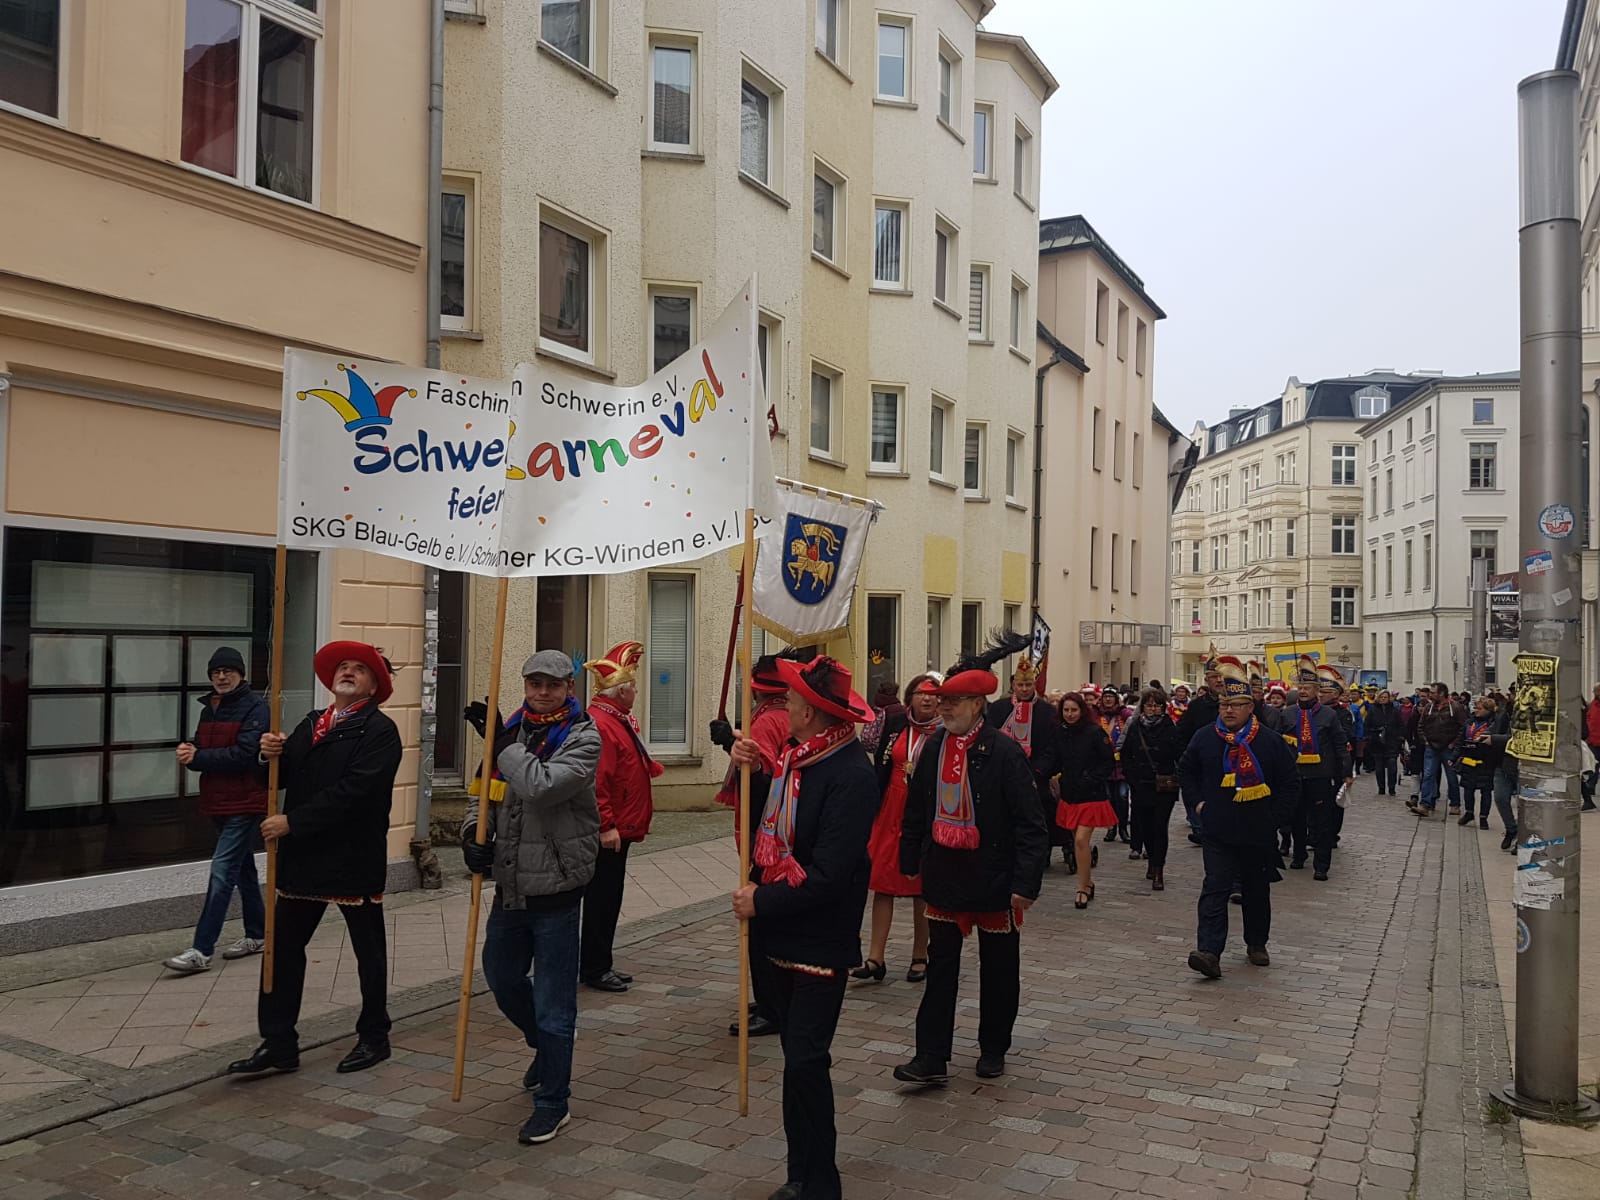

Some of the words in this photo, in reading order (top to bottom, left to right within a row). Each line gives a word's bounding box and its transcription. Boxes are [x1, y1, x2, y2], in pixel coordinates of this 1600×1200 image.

[541, 382, 646, 417] Schwerin
[653, 375, 686, 408] e.V.
[292, 516, 346, 539] SKG
[354, 521, 443, 559] Blau-Gelb
[544, 538, 684, 568] KG-Winden
